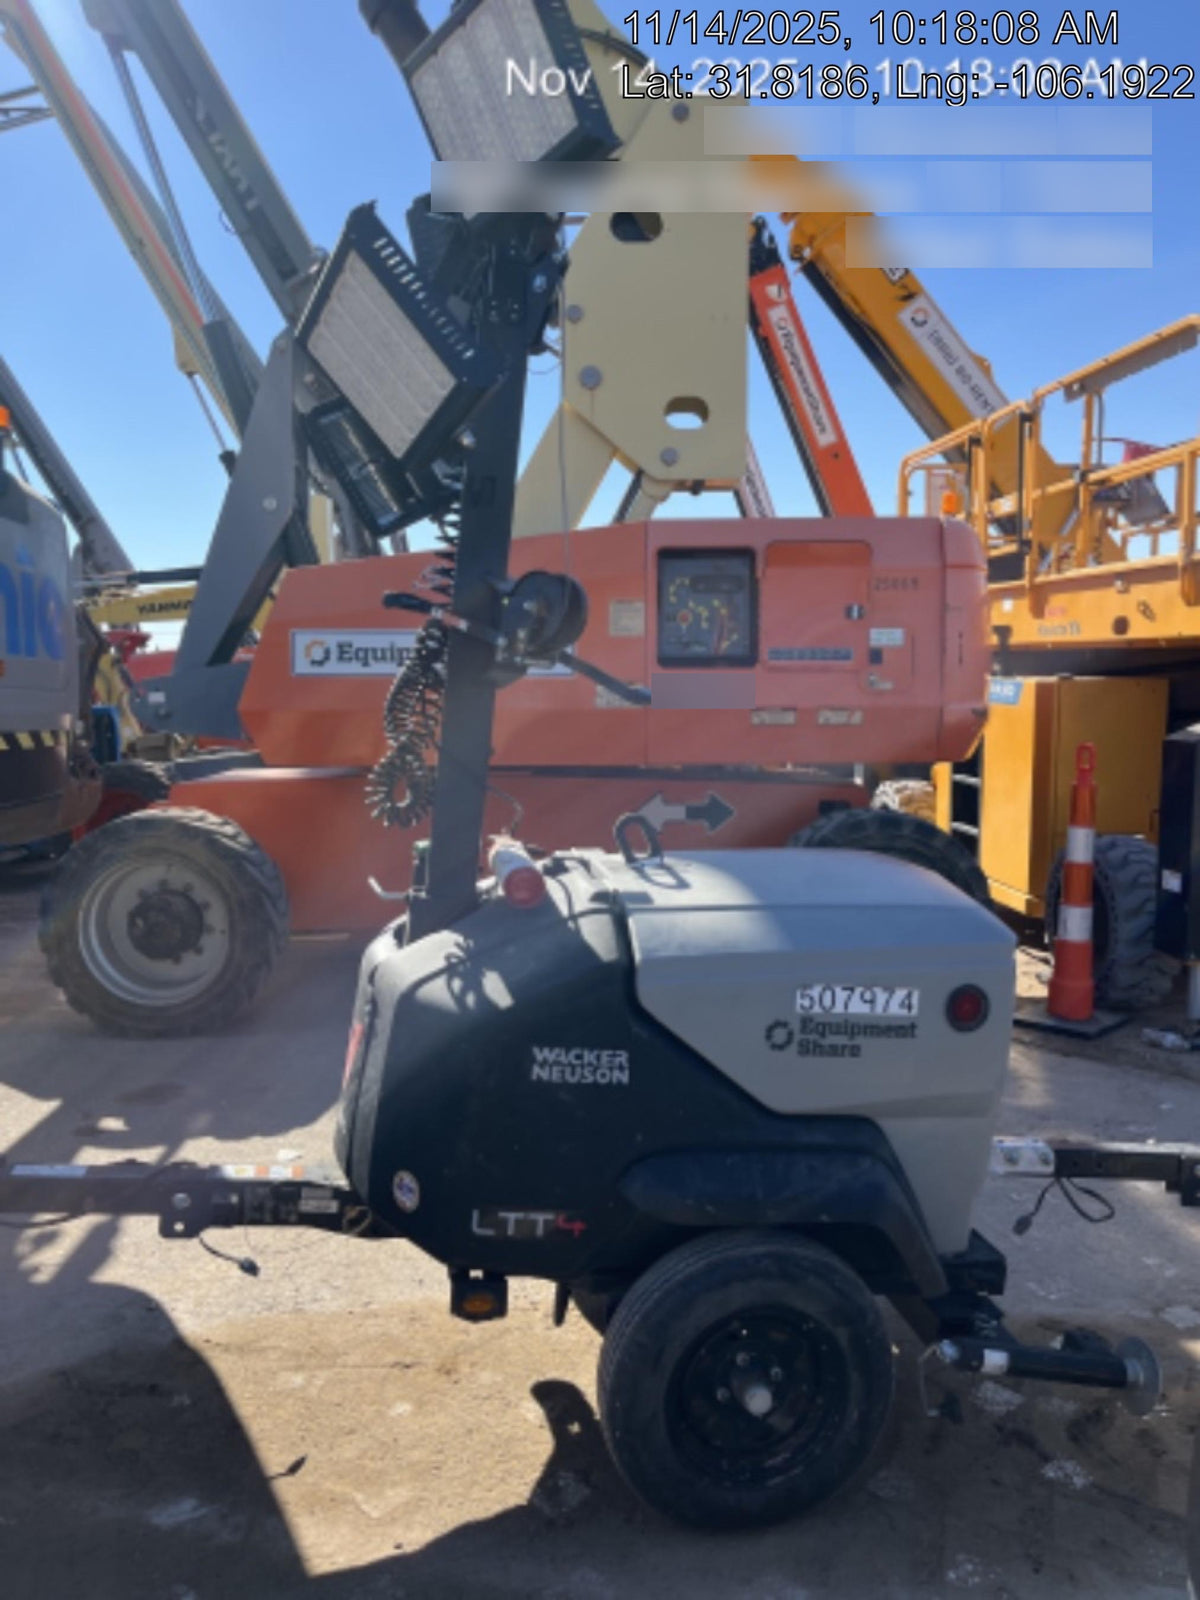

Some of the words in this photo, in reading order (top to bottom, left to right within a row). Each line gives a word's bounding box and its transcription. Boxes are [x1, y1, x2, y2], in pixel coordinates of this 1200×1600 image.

[798, 985, 913, 1014] 507974
[799, 1017, 918, 1041] Equipment
[531, 1046, 629, 1067] WACKER
[797, 1037, 862, 1057] Share
[531, 1064, 629, 1085] NEUSON
[472, 1209, 586, 1237] LTT4
